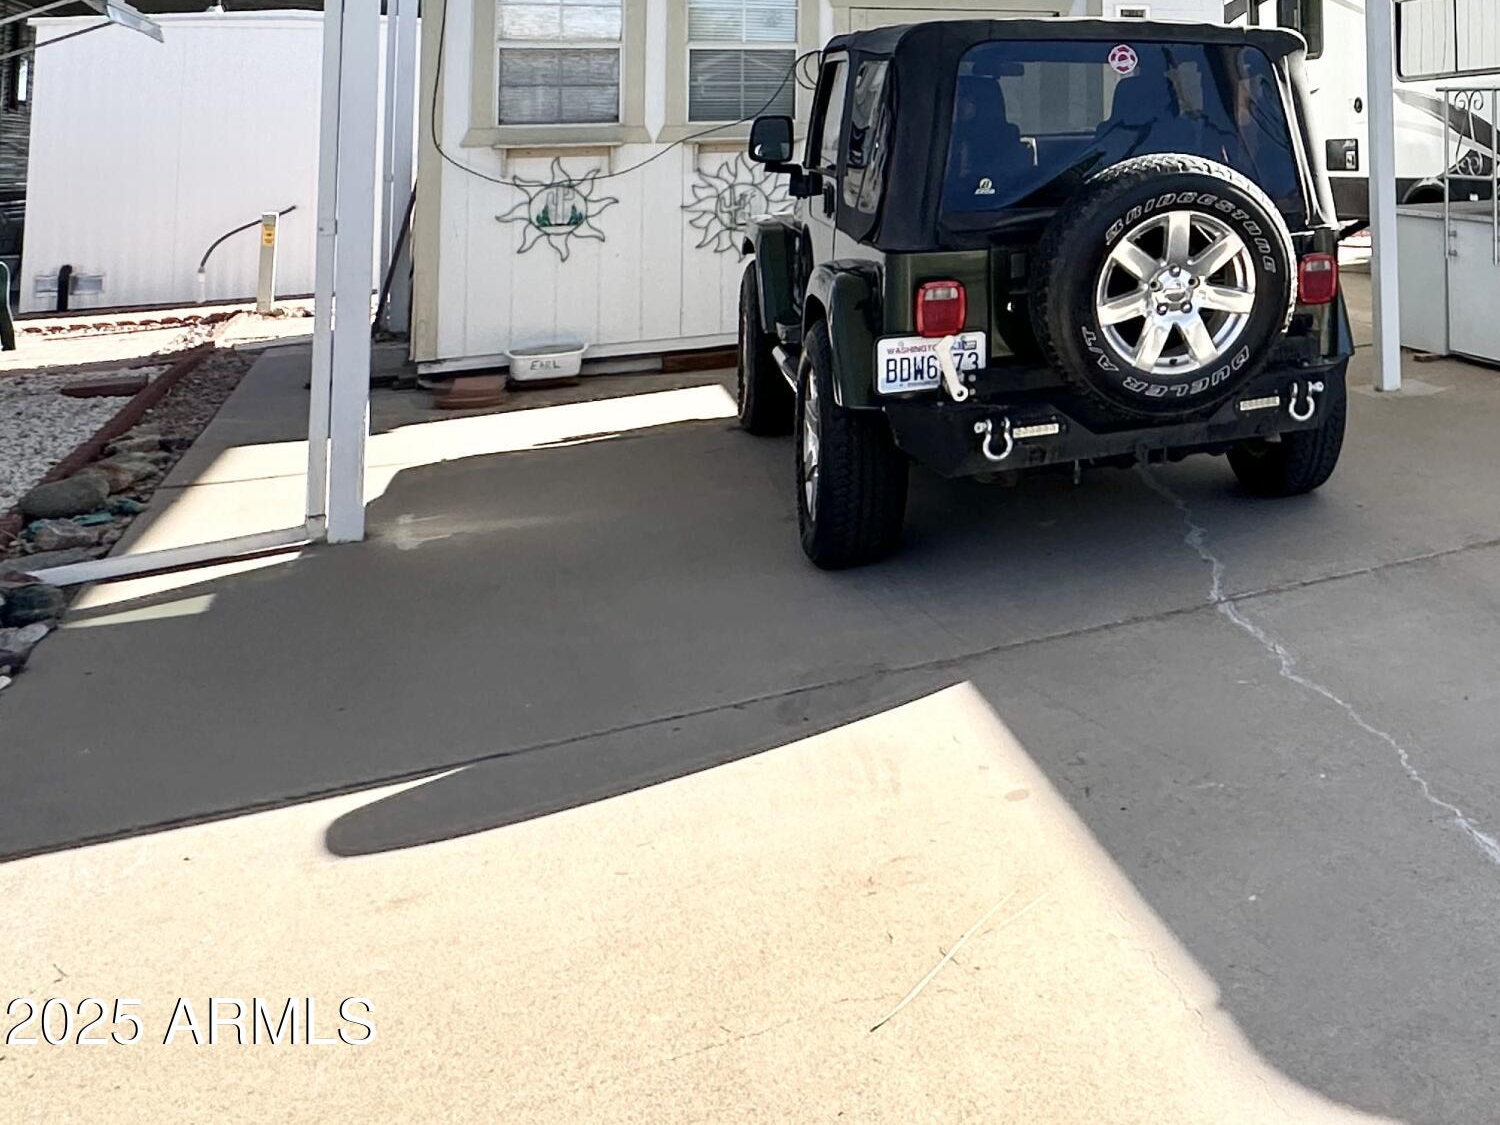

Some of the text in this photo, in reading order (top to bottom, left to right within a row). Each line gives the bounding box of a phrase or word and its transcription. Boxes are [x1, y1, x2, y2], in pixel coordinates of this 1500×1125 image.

[1105, 191, 1277, 274] BRIDGESTONE
[885, 351, 980, 384] BDW673
[886, 344, 938, 355] WASHINGTO
[1122, 345, 1250, 398] DUELER
